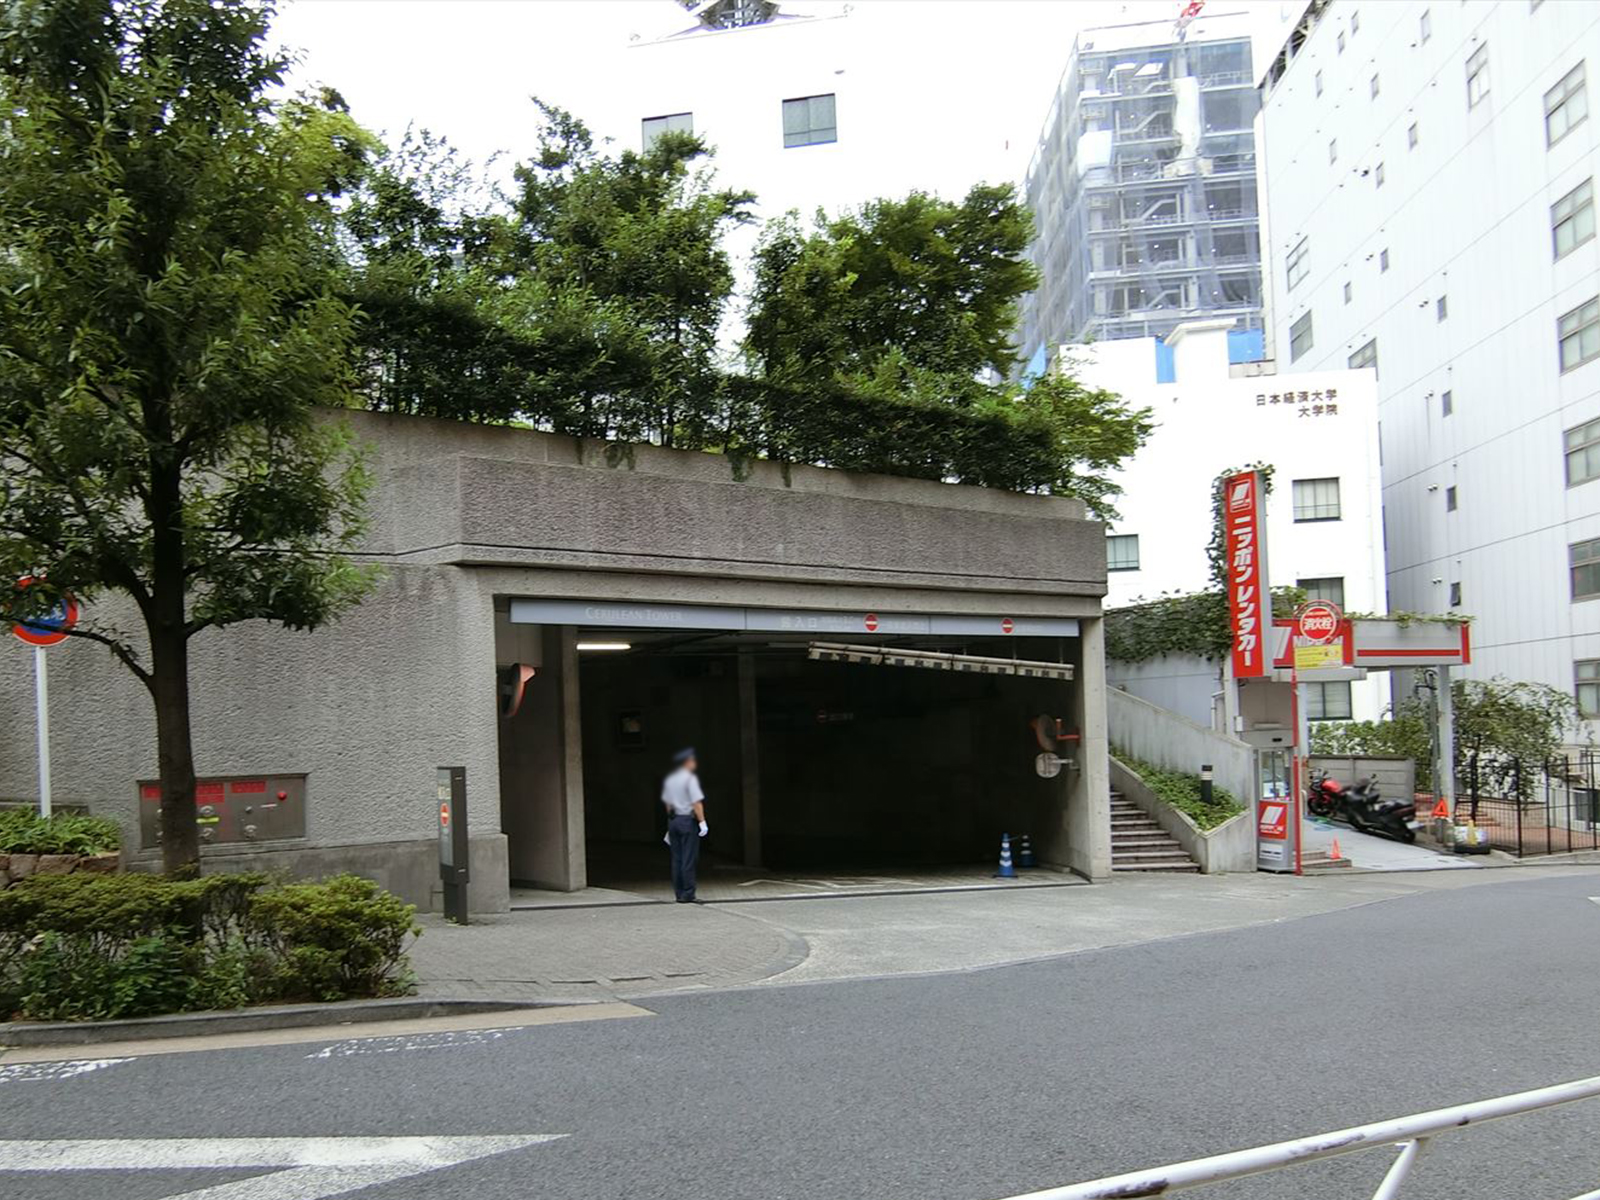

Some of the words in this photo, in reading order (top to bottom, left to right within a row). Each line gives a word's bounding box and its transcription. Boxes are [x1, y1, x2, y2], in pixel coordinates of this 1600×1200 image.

[1232, 515, 1256, 667] ニッポンレンタカー
